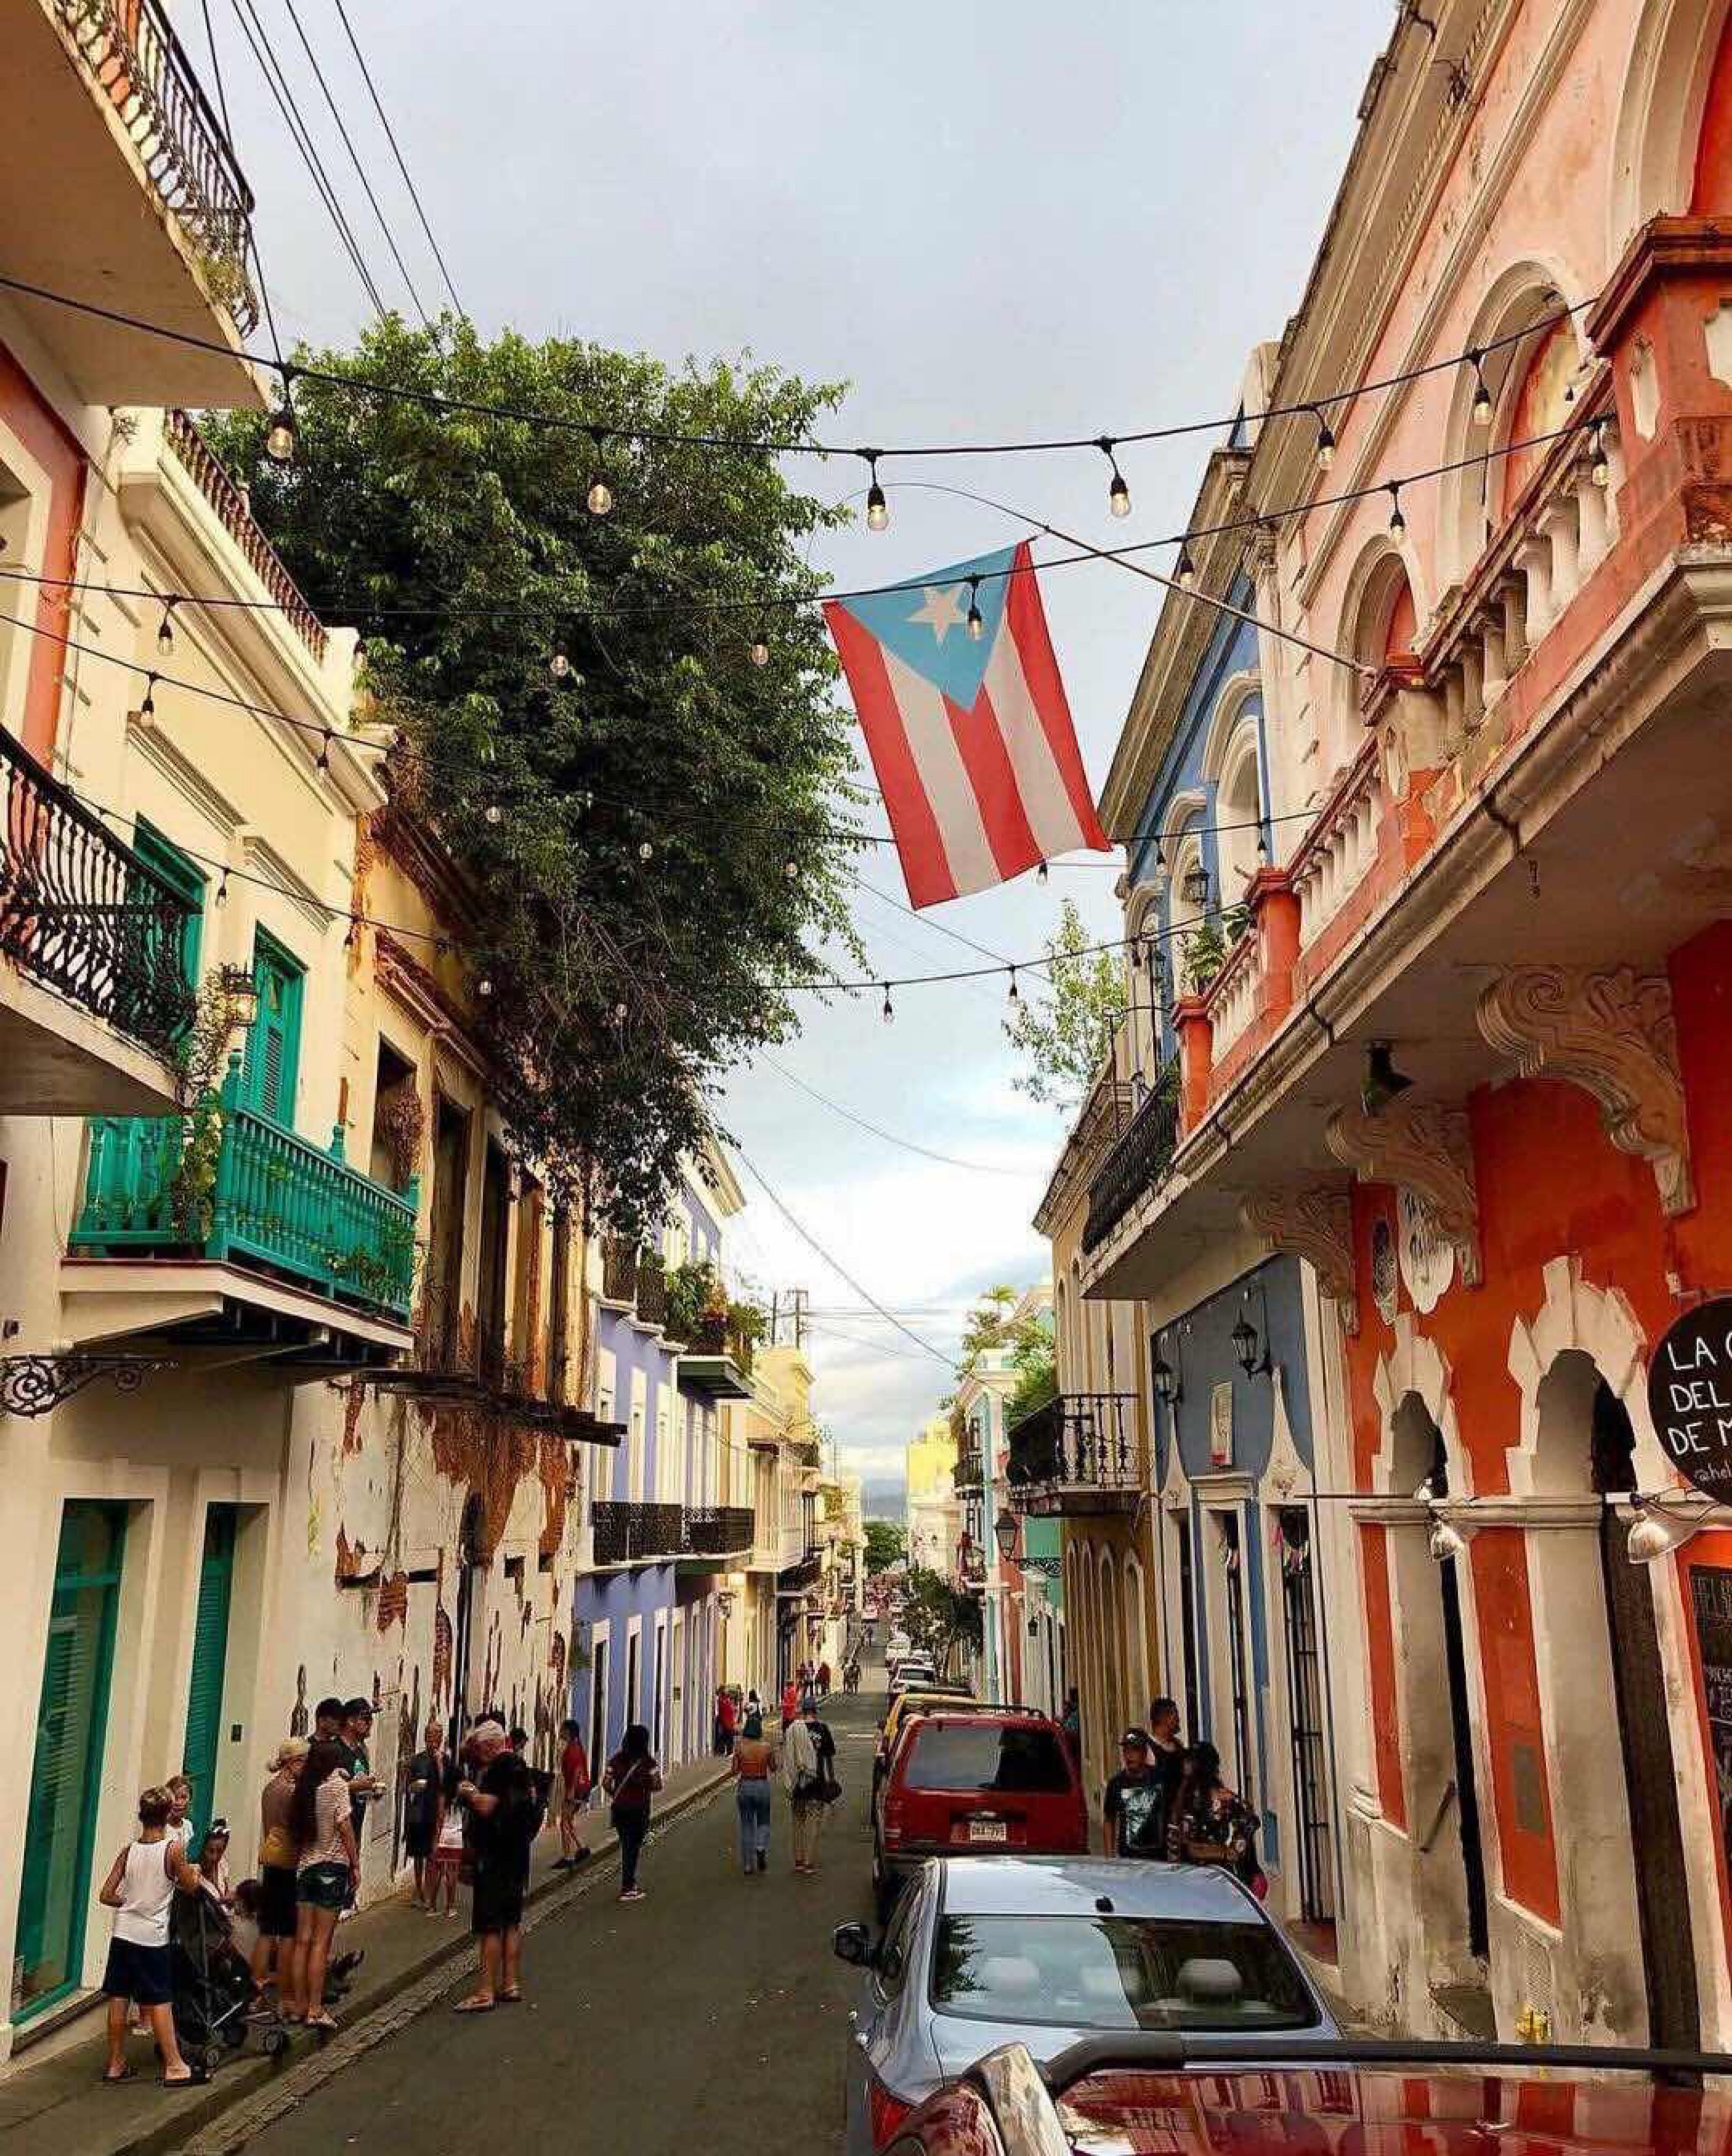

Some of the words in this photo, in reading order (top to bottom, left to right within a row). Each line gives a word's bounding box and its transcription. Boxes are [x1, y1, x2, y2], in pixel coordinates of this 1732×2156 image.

[1667, 1336, 1717, 1370] LA
[1669, 1381, 1731, 1412] DEL
[1668, 1421, 1710, 1455] DE
